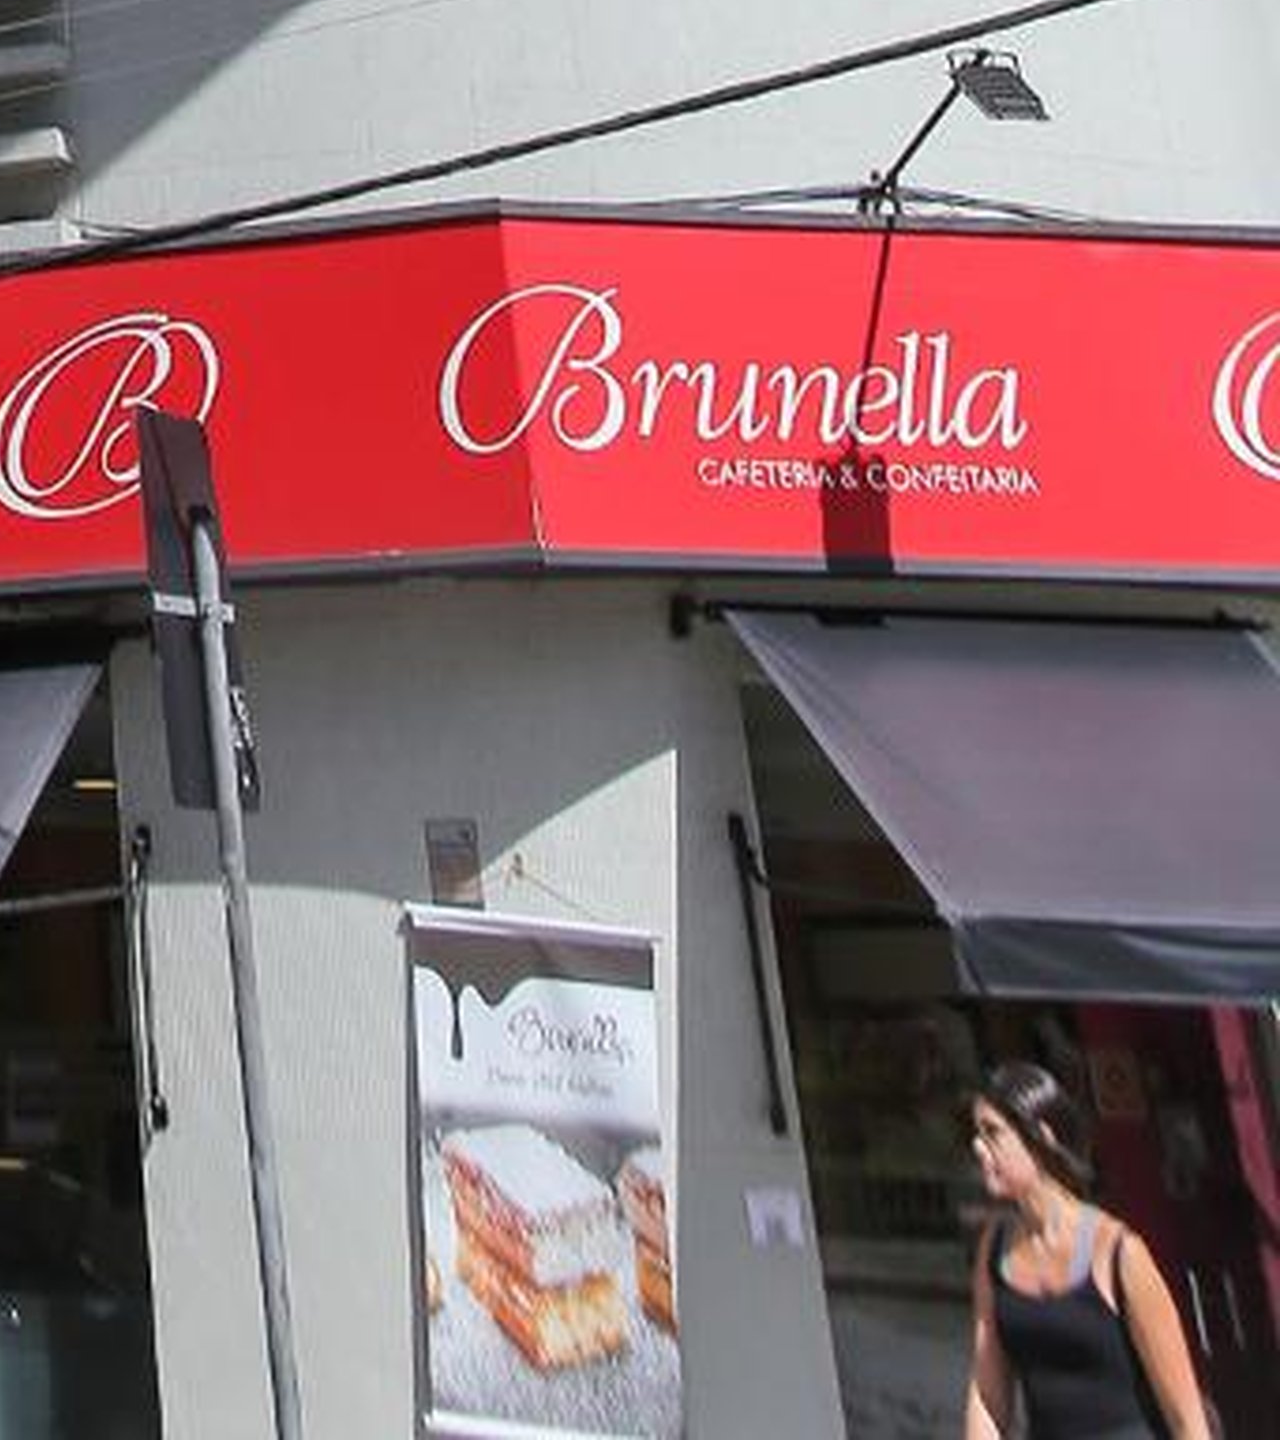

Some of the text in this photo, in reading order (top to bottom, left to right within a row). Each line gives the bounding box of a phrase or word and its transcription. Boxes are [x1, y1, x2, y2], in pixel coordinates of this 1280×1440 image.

[440, 283, 1027, 453] Brunella
[696, 458, 1040, 495] CAFETERIA & CONFEITARIA
